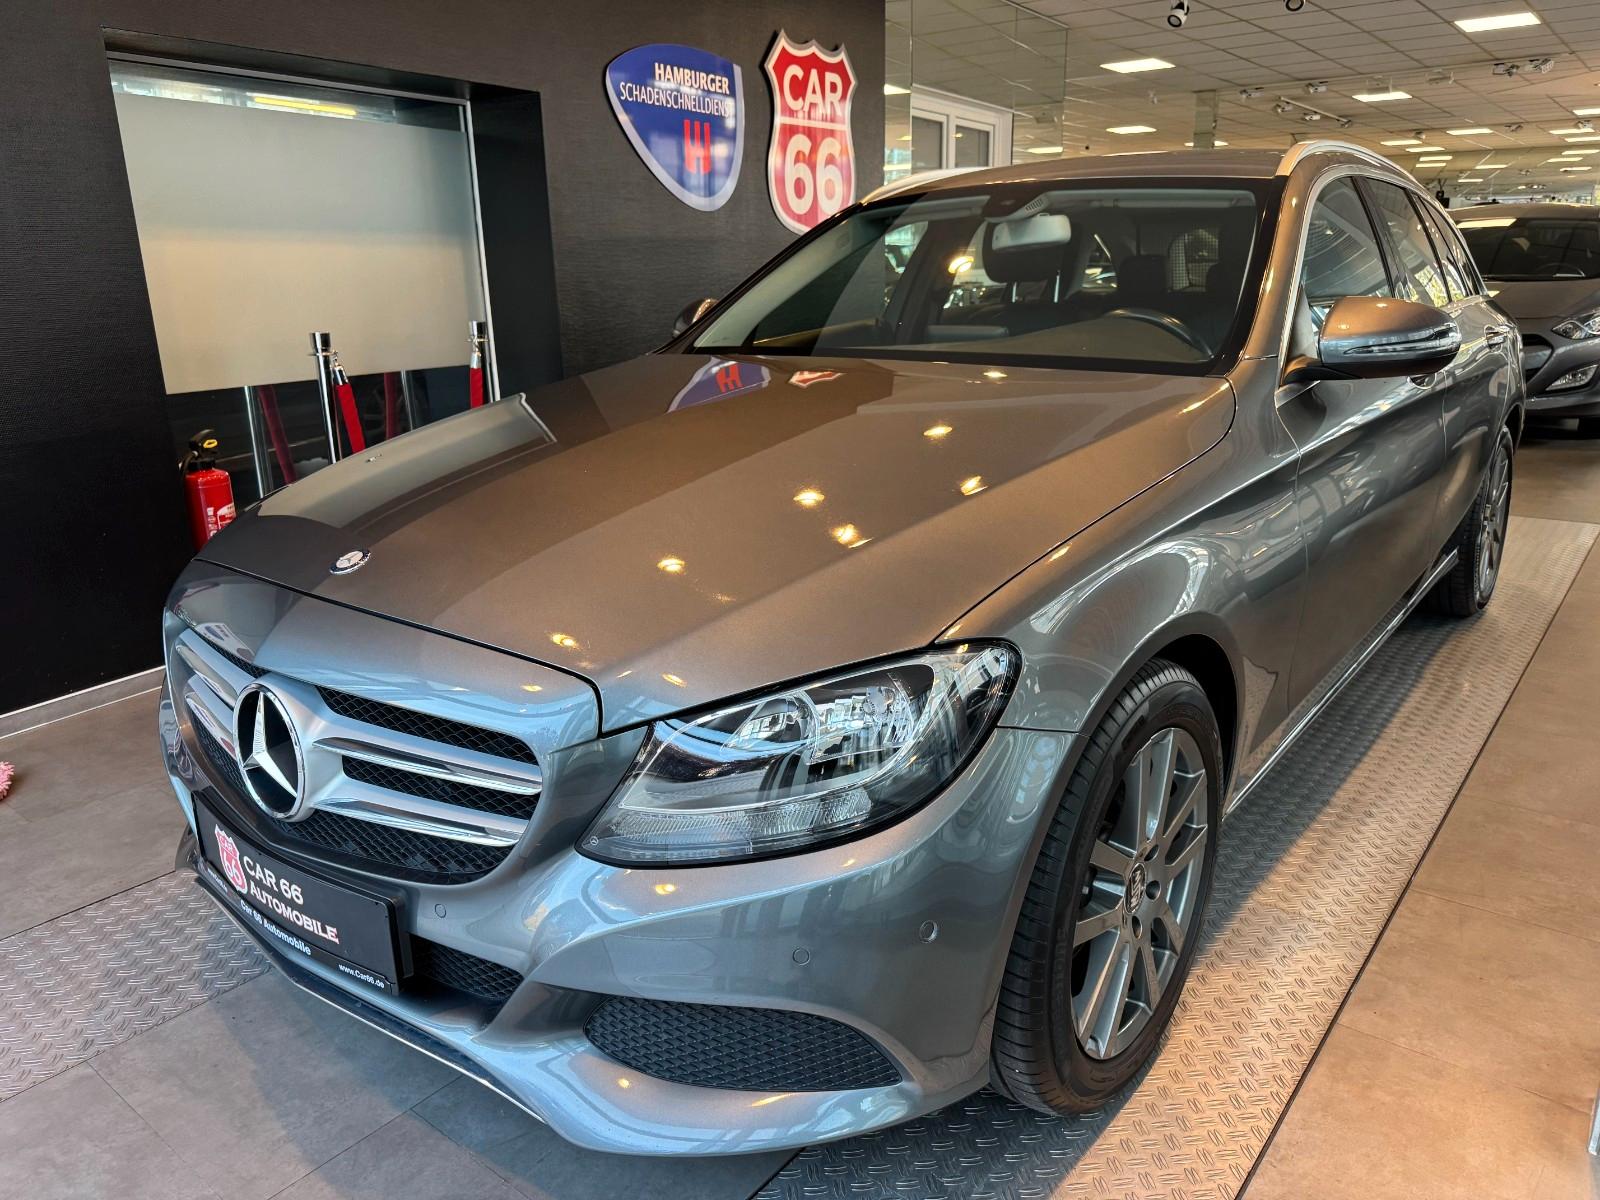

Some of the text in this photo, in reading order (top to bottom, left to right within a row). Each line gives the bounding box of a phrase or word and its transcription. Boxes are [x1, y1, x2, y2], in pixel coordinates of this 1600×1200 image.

[654, 62, 730, 95] HAMBURGER
[783, 63, 843, 117] CAR
[784, 133, 844, 215] 66
[243, 855, 279, 893] CAR
[279, 878, 304, 906] 66
[240, 898, 253, 917] Car
[263, 918, 312, 956] Automobile
[249, 879, 340, 945] AUTOMOBILE
